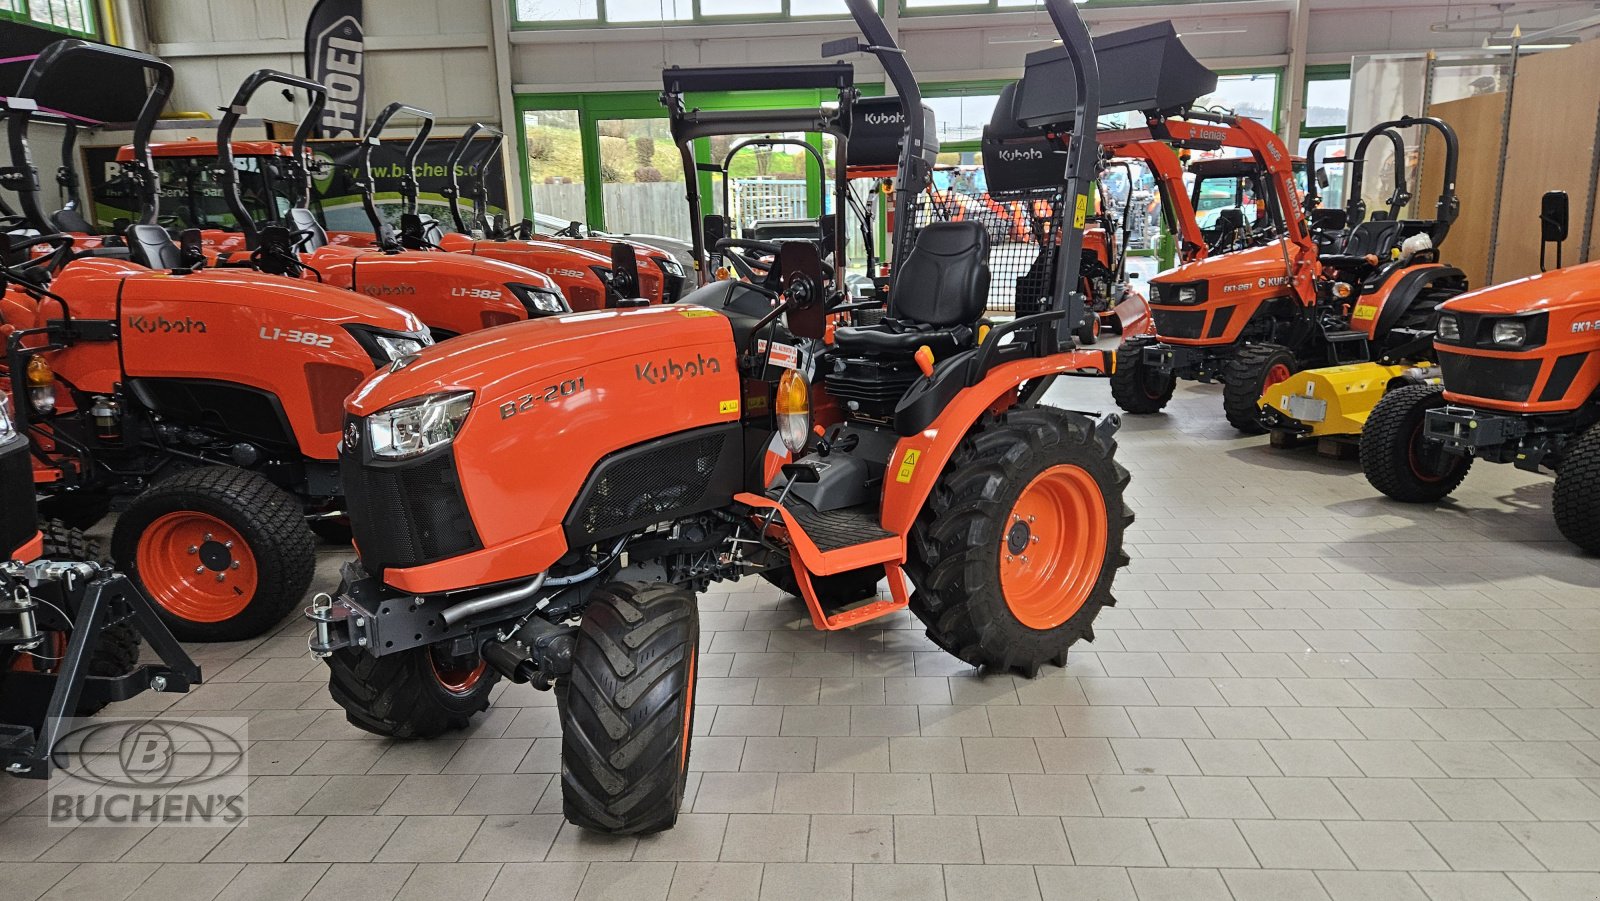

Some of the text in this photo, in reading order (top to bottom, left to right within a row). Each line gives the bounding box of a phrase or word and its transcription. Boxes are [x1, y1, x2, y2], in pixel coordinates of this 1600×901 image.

[999, 148, 1043, 161] Kubota
[1285, 177, 1301, 219] KUBOTA
[546, 267, 585, 279] L1-382
[363, 282, 502, 300] Kubota L1-382
[129, 315, 335, 348] Kubota L1-382
[634, 353, 721, 385] Kubota
[499, 376, 586, 420] B2-201
